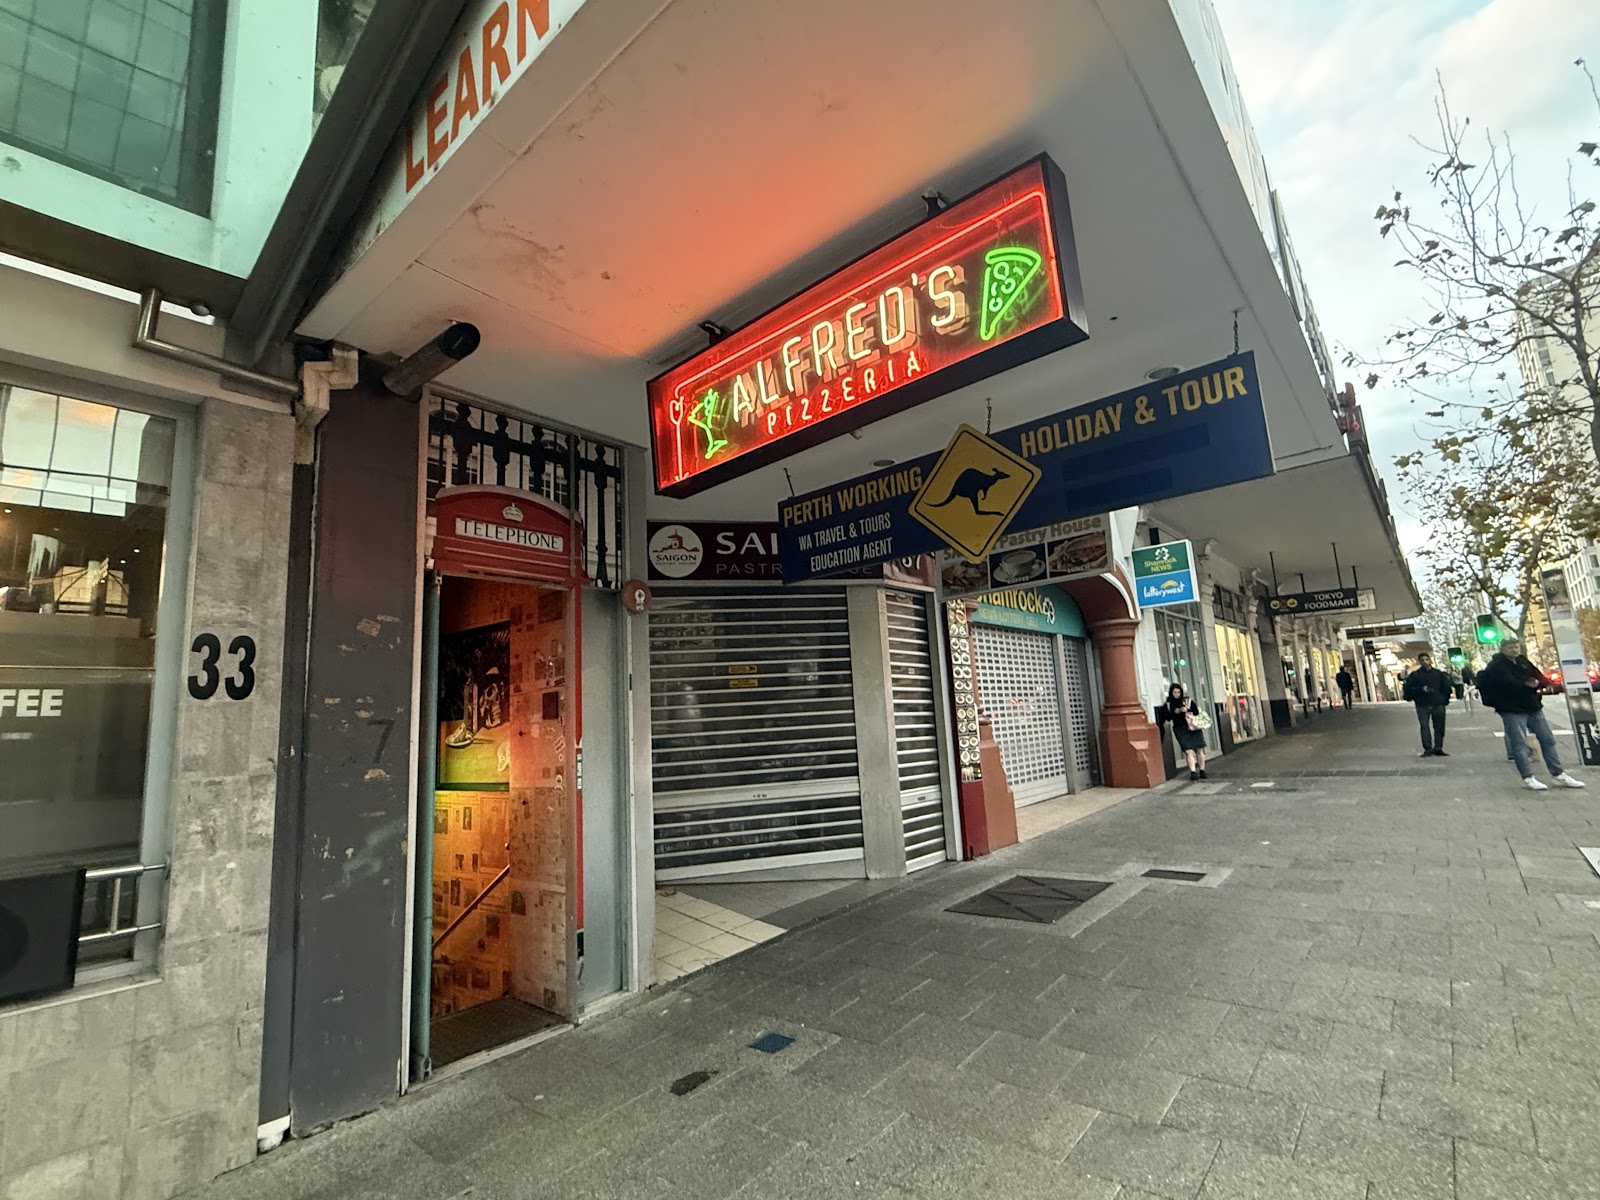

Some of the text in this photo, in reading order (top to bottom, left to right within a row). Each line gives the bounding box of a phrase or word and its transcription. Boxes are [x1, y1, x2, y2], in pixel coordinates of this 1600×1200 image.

[405, 0, 550, 194] LEARN
[732, 265, 964, 426] ALFRED'S
[767, 350, 922, 436] PIZZERIA
[783, 366, 1248, 528] PERTH WORKING HOLIDAY & TOUR
[460, 518, 561, 551] TELEPHONE
[798, 512, 891, 551] WA TRAVEL & TOURS
[999, 516, 1101, 548] Pastry House
[656, 553, 697, 562] SAIGON
[716, 563, 783, 575] PASTR
[810, 537, 892, 573] EDUCATION AGENT
[1143, 556, 1177, 568] Shamrock
[1151, 563, 1173, 573] NEWS
[977, 587, 1044, 614] hamrock
[1143, 580, 1186, 599] lotterywest
[1313, 591, 1344, 601] TOKYO
[187, 633, 257, 701] 33
